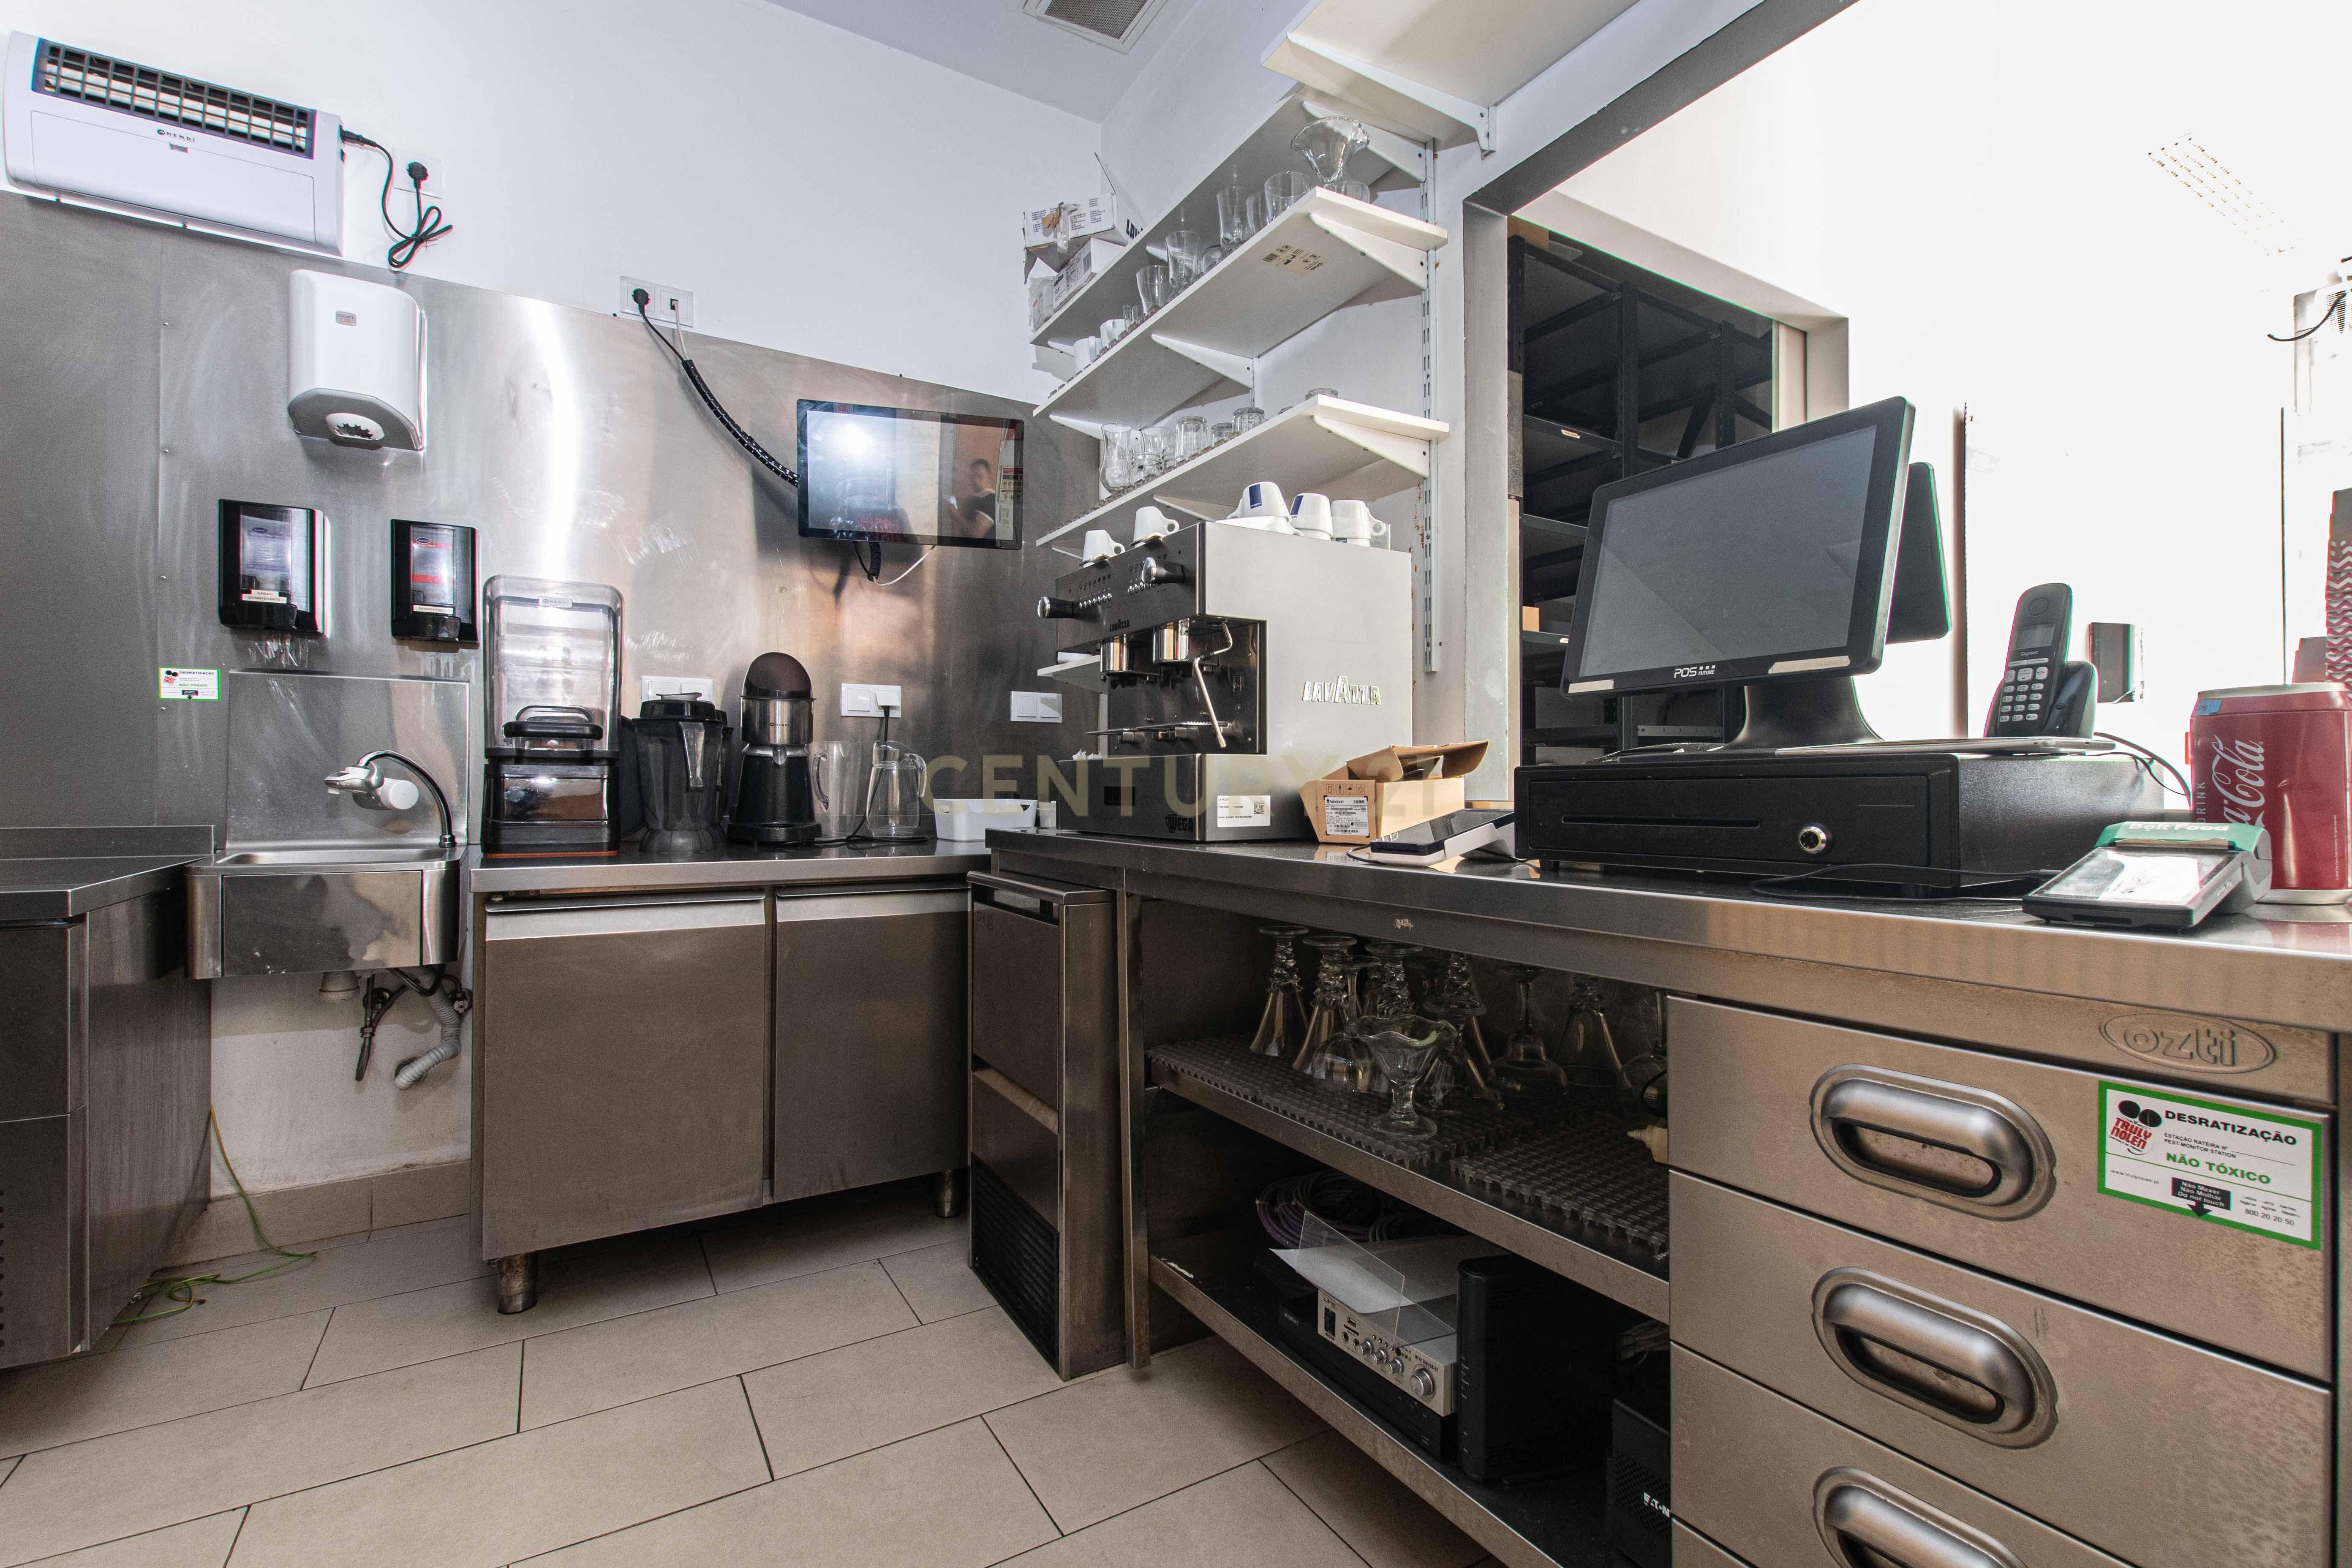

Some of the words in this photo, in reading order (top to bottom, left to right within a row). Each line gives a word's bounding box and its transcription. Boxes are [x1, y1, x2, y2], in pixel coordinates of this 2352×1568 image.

[1110, 619, 1130, 632] LAVAZZA
[1674, 667, 1697, 678] POS
[1302, 675, 1381, 705] LAVAZZA
[2212, 734, 2265, 827] a-Cola
[2197, 782, 2205, 823] DRINK
[2115, 1117, 2152, 1140] TRULY
[2164, 1110, 2297, 1145] DESRATIZAÇÃO
[2110, 1126, 2147, 1149] NOLEN
[2164, 1132, 2192, 1143] ESTAÇÃO
[2194, 1139, 2220, 1149] RATEIRA
[2210, 1149, 2236, 1158] STATION
[2166, 1152, 2200, 1168] NÃO
[2205, 1161, 2271, 1184] TÓXICO
[2196, 1190, 2221, 1200] Molhar
[2198, 1185, 2220, 1195] Mexer
[2203, 1198, 2225, 1207] touch
[2245, 1208, 2259, 1217] 800
